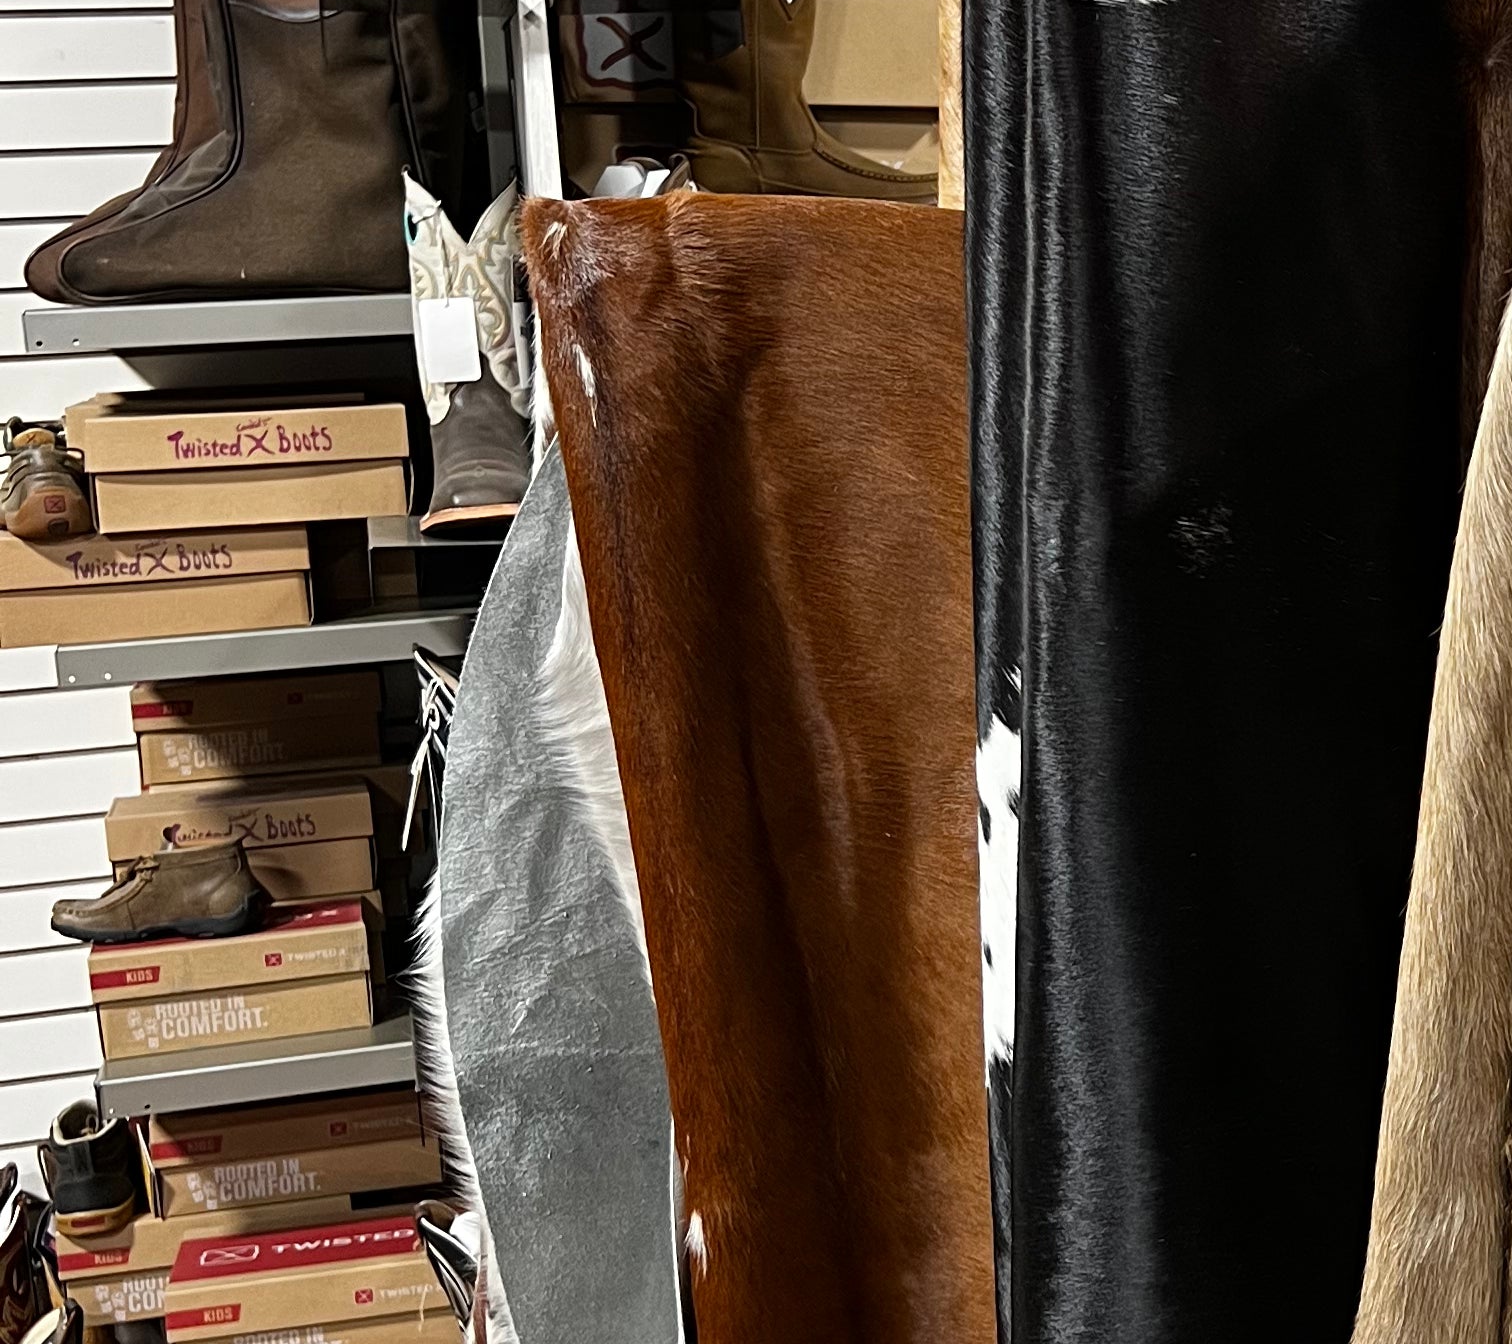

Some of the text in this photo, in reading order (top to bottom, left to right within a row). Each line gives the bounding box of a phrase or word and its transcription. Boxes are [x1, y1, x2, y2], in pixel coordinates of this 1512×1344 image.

[167, 425, 333, 460] Twisted X Boots
[66, 543, 233, 580] Twisted X Boots
[265, 813, 316, 840] Boots
[125, 969, 153, 984] KIDS
[154, 994, 245, 1020] ROOTED IN
[214, 1159, 300, 1182] ROOTED IN
[271, 1229, 415, 1254] TWISTED
[122, 1276, 169, 1294] ROOT
[202, 1306, 234, 1325] KIDS
[306, 1326, 325, 1344] IN
